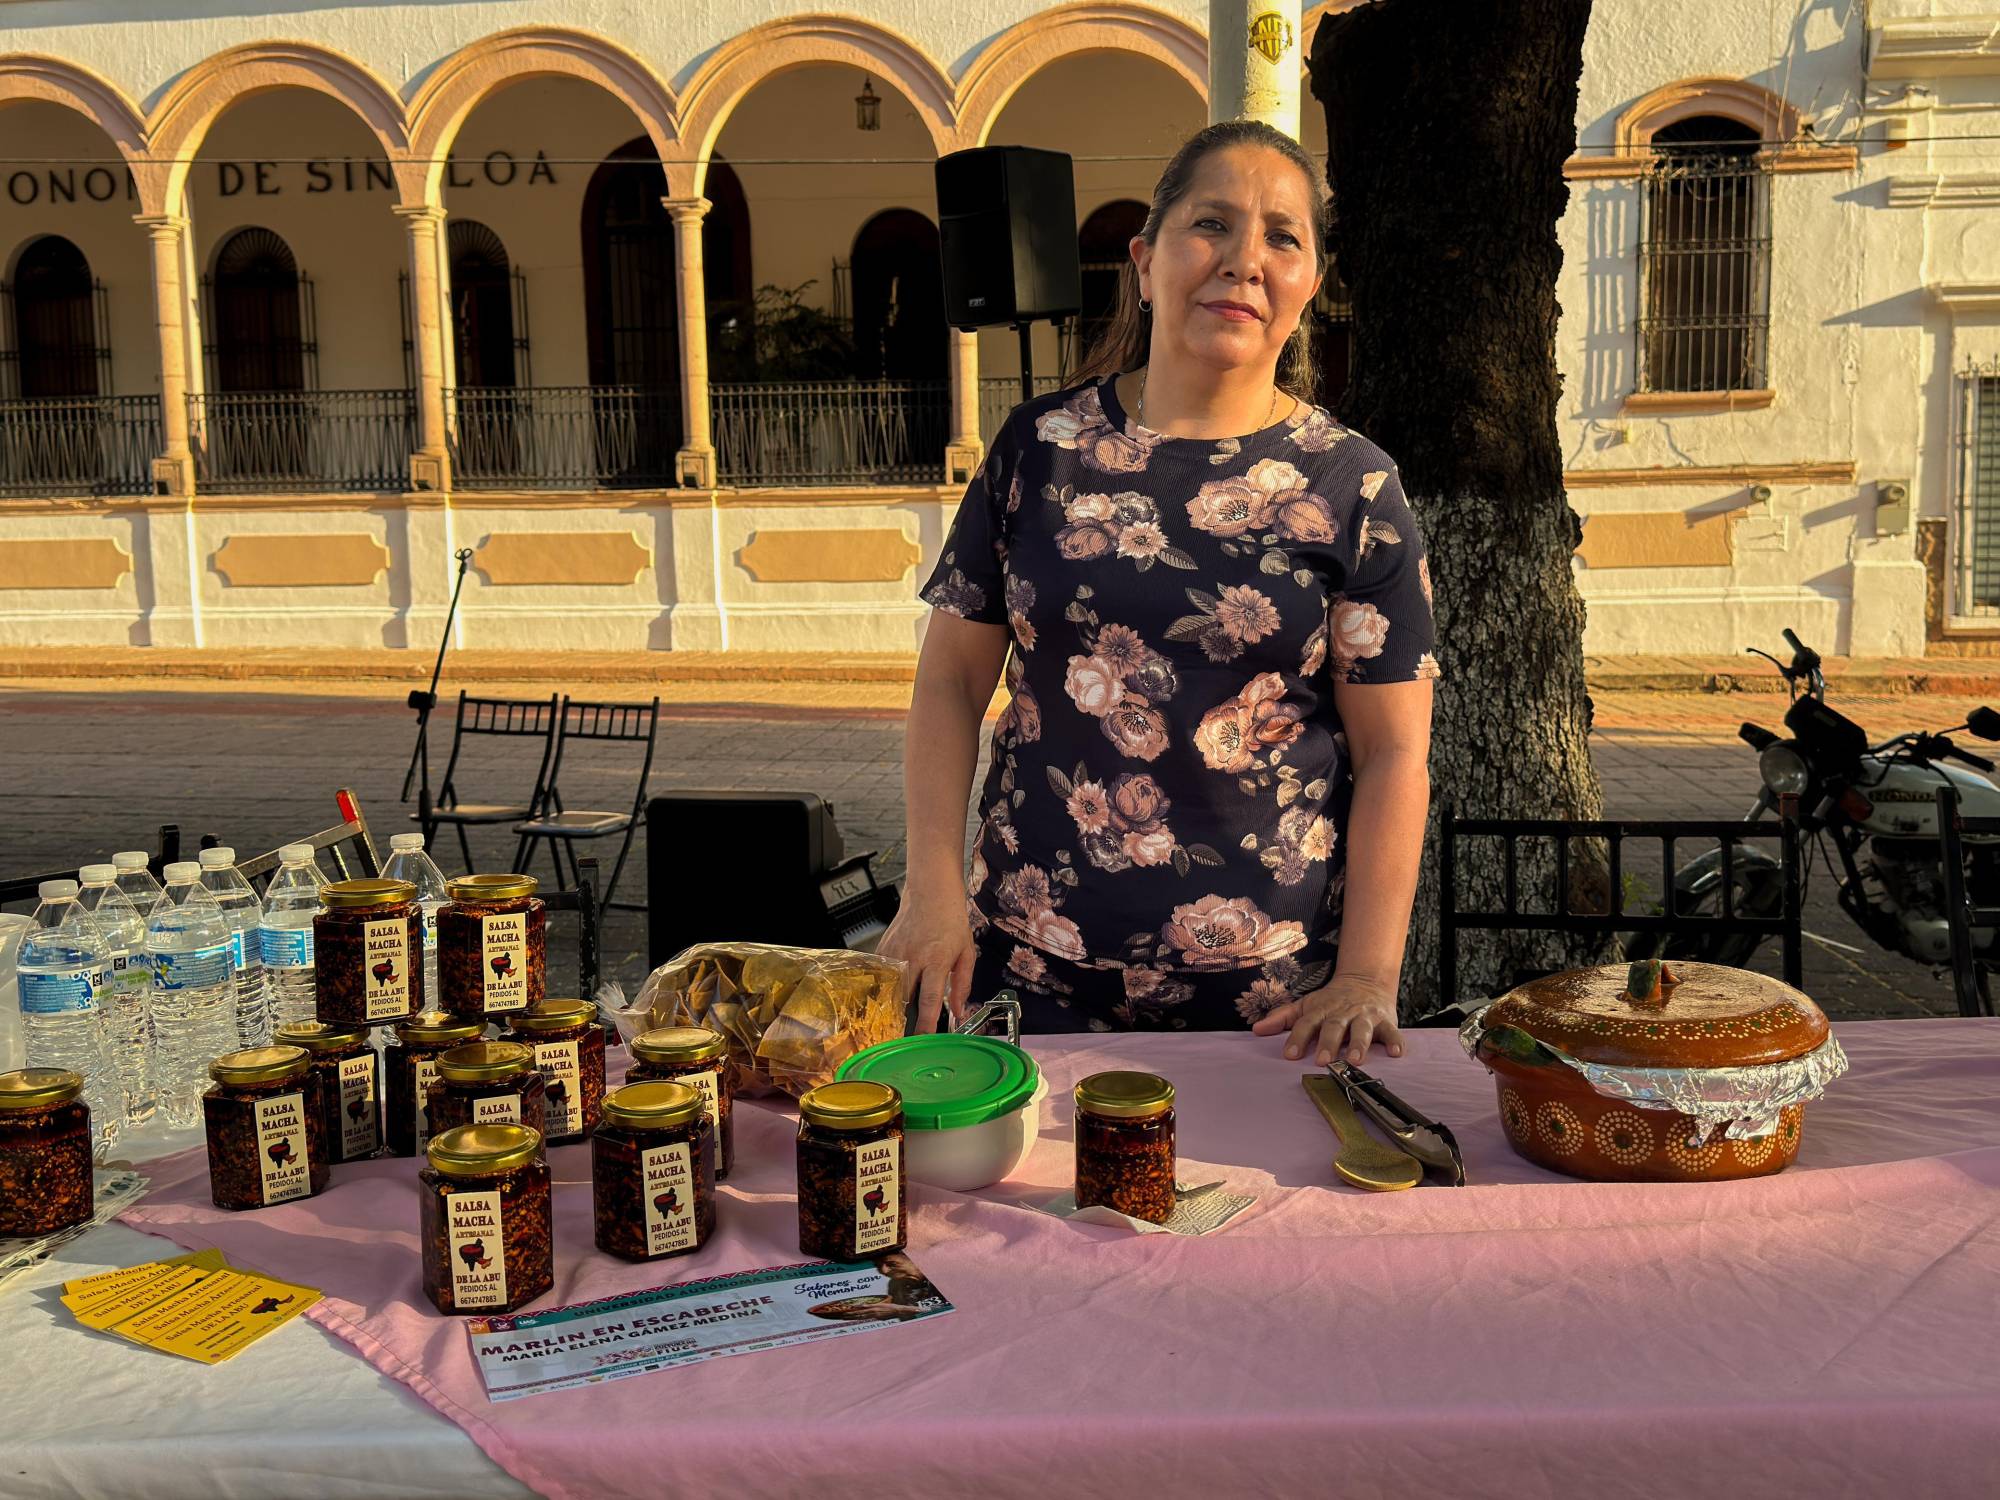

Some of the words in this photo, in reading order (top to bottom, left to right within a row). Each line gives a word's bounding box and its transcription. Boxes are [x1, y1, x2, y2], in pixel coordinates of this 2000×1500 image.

[219, 161, 281, 196] DE
[306, 150, 558, 193] SINLOA
[371, 926, 400, 937] SALSA
[489, 921, 517, 930] SALSA
[368, 939, 402, 950] MACHA
[487, 933, 520, 943] MACHA
[370, 951, 401, 959] ARTESANAL
[380, 989, 389, 997] LA
[391, 987, 405, 996] ABU
[498, 982, 506, 990] LA
[490, 990, 511, 998] PEDIDOS
[542, 1049, 570, 1059] SALSA
[344, 1062, 368, 1076] SALSA
[540, 1061, 573, 1072] MACHA
[343, 1075, 370, 1089] MACHA
[263, 1103, 295, 1117] SALSA
[480, 1103, 512, 1115] SALSA
[564, 1108, 577, 1116] ABU
[262, 1116, 298, 1131] MACHA
[264, 1128, 298, 1140] ARTESANAL
[649, 1151, 682, 1166] SALSA
[862, 1148, 890, 1162] SALSA
[266, 1173, 276, 1181] DE
[277, 1170, 287, 1179] LA
[290, 1167, 305, 1177] ABU
[648, 1165, 686, 1180] MACHA
[860, 1161, 893, 1177] MACHA
[269, 1179, 294, 1189] PEDIDOS
[650, 1178, 685, 1190] ARTESANAL
[861, 1175, 892, 1187] ARTESANAL
[455, 1201, 491, 1212] SALSA
[453, 1216, 495, 1227] MACHA
[651, 1224, 661, 1232] DE
[663, 1221, 674, 1230] LA
[676, 1217, 691, 1227] ABU
[859, 1221, 868, 1230] DE
[870, 1219, 879, 1228] LA
[881, 1215, 895, 1225] ABU
[456, 1230, 494, 1238] ARTESANAL
[655, 1229, 679, 1240] PEDIDOS
[862, 1228, 883, 1238] PEDIDOS
[885, 1225, 891, 1233] AL
[82, 1274, 112, 1284] Salsa
[115, 1266, 152, 1277] Macha
[456, 1275, 467, 1283] DE
[469, 1274, 481, 1283] LA
[483, 1273, 500, 1281] ABU
[78, 1288, 108, 1300] Salsa
[110, 1276, 146, 1290] Macha
[574, 1293, 674, 1317] UNIVERSIDAD
[784, 1267, 846, 1278] SINALOA
[794, 1280, 851, 1295] Sabores
[857, 1275, 881, 1283] con
[808, 1284, 870, 1299] Memoria
[94, 1304, 121, 1318] Salsa
[121, 1287, 153, 1304] Macha
[129, 1300, 145, 1310] DE
[145, 1293, 159, 1302] LA
[160, 1282, 182, 1293] ABU
[132, 1310, 158, 1327] Salsa
[158, 1297, 189, 1313] Macha
[188, 1272, 230, 1297] Artesanal
[461, 1295, 496, 1304] 6674747883
[154, 1316, 180, 1331] Salsa
[179, 1300, 210, 1318] Macha
[165, 1327, 192, 1341] Salsa
[190, 1309, 221, 1328] Macha
[221, 1284, 263, 1310] Artesanal
[201, 1322, 217, 1332] DE
[216, 1315, 230, 1324] LA
[230, 1303, 249, 1314] ABU
[482, 1332, 585, 1356] MARLIN
[593, 1324, 625, 1336] EN
[632, 1296, 774, 1328] ESCABECHE
[503, 1347, 564, 1362] MARÍA
[569, 1335, 624, 1350] ELENA
[628, 1322, 689, 1338] GÁMEZ
[694, 1309, 762, 1326] MEDINA
